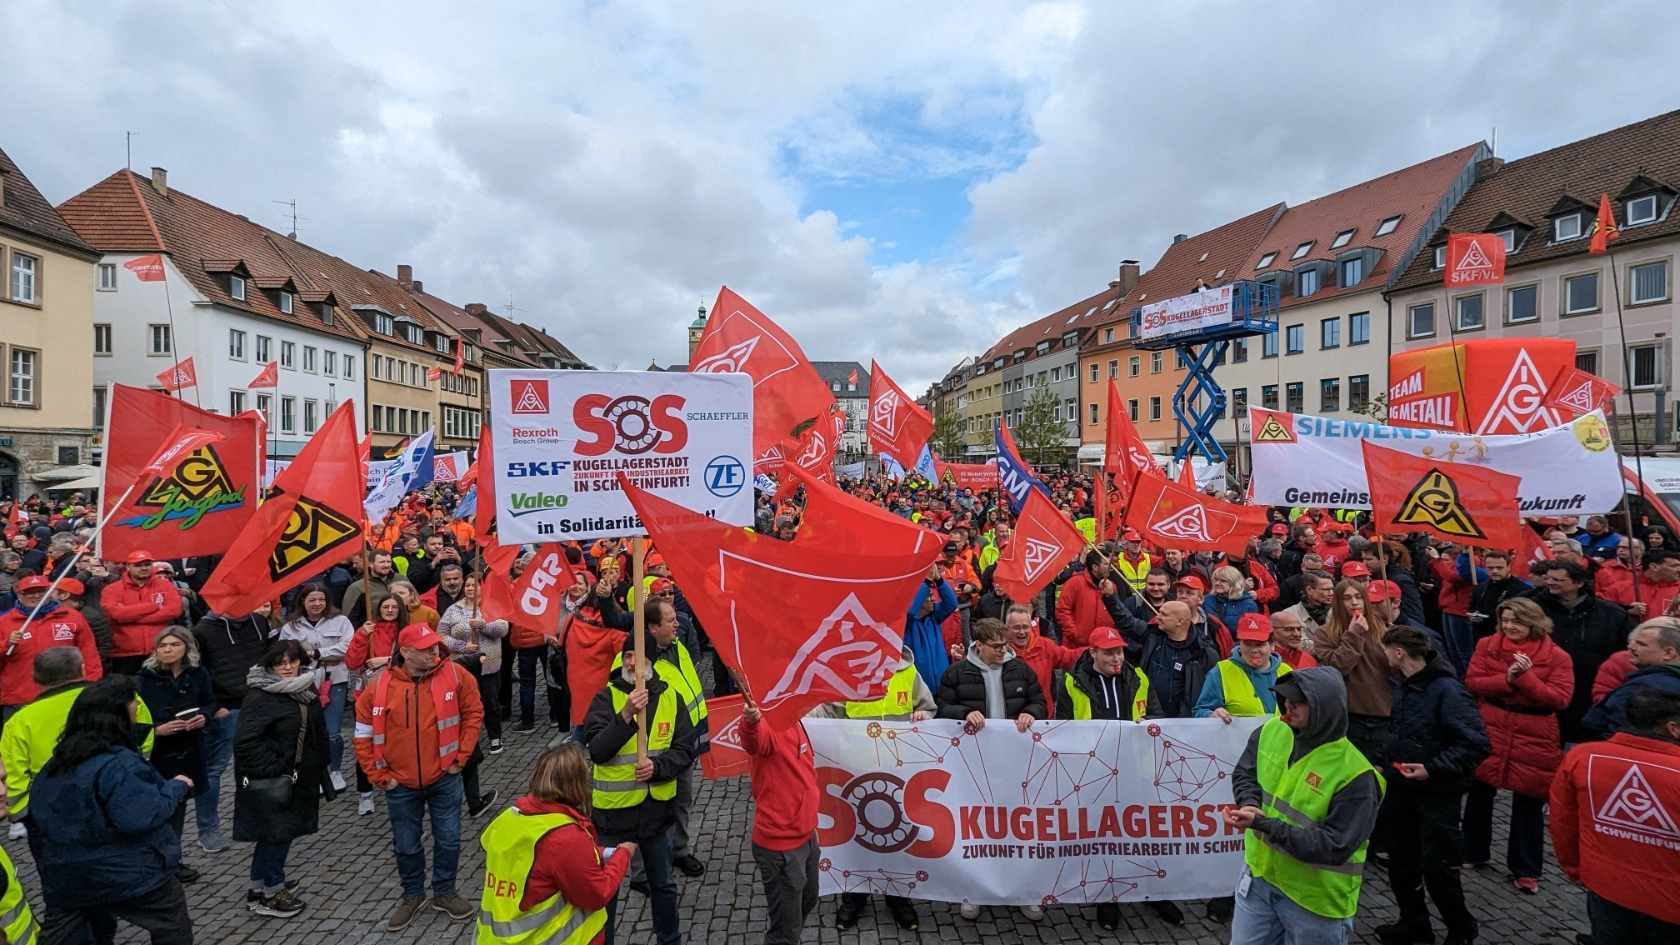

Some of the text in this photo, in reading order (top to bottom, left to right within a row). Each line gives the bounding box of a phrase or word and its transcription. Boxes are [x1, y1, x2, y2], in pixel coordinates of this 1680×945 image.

[1451, 270, 1499, 283] SKF/VL
[1144, 309, 1167, 330] SOS
[1166, 303, 1229, 322] KUGELLAGERSTADT
[1390, 371, 1422, 399] TEAM
[686, 412, 749, 421] SCHAEFFLER
[1389, 396, 1454, 427] IG METALL
[512, 427, 559, 438] Rexroth
[572, 393, 688, 456] SOS
[534, 437, 559, 445] Group
[870, 431, 901, 455] Schweinfurt
[507, 461, 571, 478] SKF
[573, 457, 689, 471] KUGELLAGERSTADT
[574, 471, 609, 480] ZUKUNFT
[627, 468, 690, 477] INDUSTRIEARBEIT
[706, 459, 743, 493] ZF
[574, 476, 690, 492] IN SCHEINFURT!
[510, 492, 568, 510] Valeo
[1284, 487, 1374, 505] Gemeins
[141, 483, 247, 530] Jugend
[537, 521, 554, 535] in
[560, 514, 646, 534] Solidaritä
[816, 765, 956, 859] SOS
[959, 803, 1246, 841] KUGELLAGERST
[1594, 824, 1680, 851] SCHWEINFUR
[962, 844, 1025, 860] ZUKUNFT
[1028, 841, 1056, 859] FÜR
[1058, 841, 1182, 858] INDUSTRIEARBEIT
[1185, 841, 1200, 855] IN
